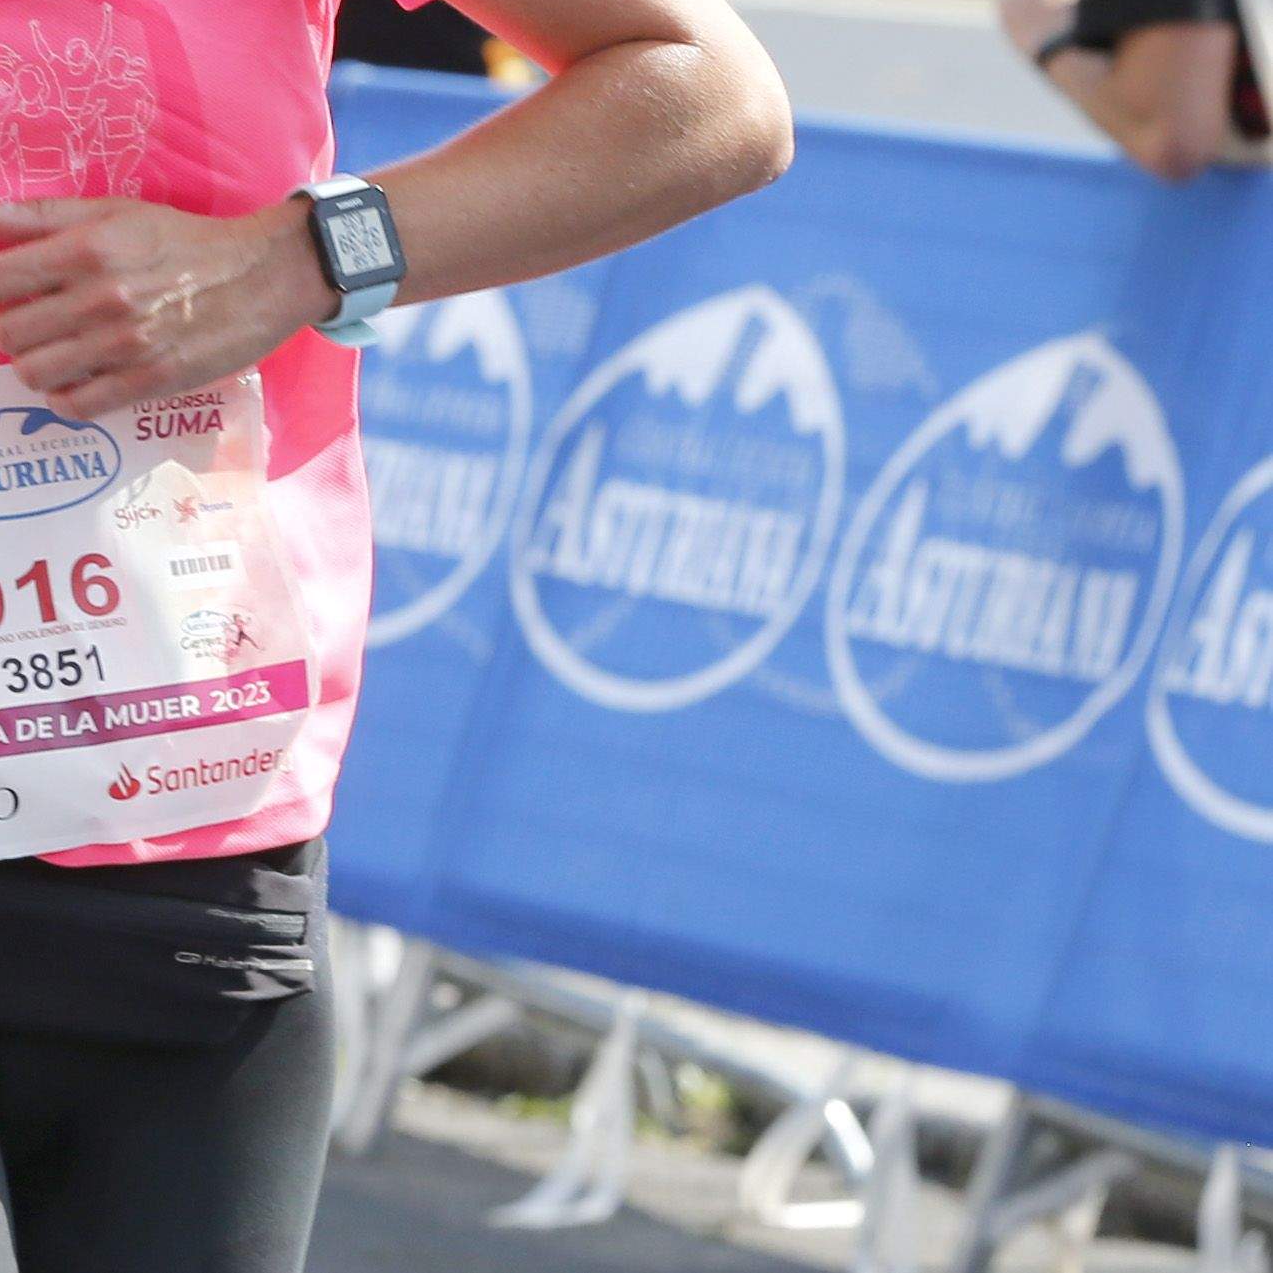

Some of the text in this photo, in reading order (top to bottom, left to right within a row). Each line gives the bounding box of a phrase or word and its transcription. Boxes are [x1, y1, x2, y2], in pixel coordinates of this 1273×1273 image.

[30, 434, 99, 452] LECHERA
[136, 409, 225, 441] SUMA
[1, 644, 105, 694] 3851
[15, 717, 54, 744] DE
[59, 713, 98, 738] LA
[103, 692, 202, 731] MUJER
[210, 681, 272, 712] 2023
[147, 748, 284, 795] Santander
